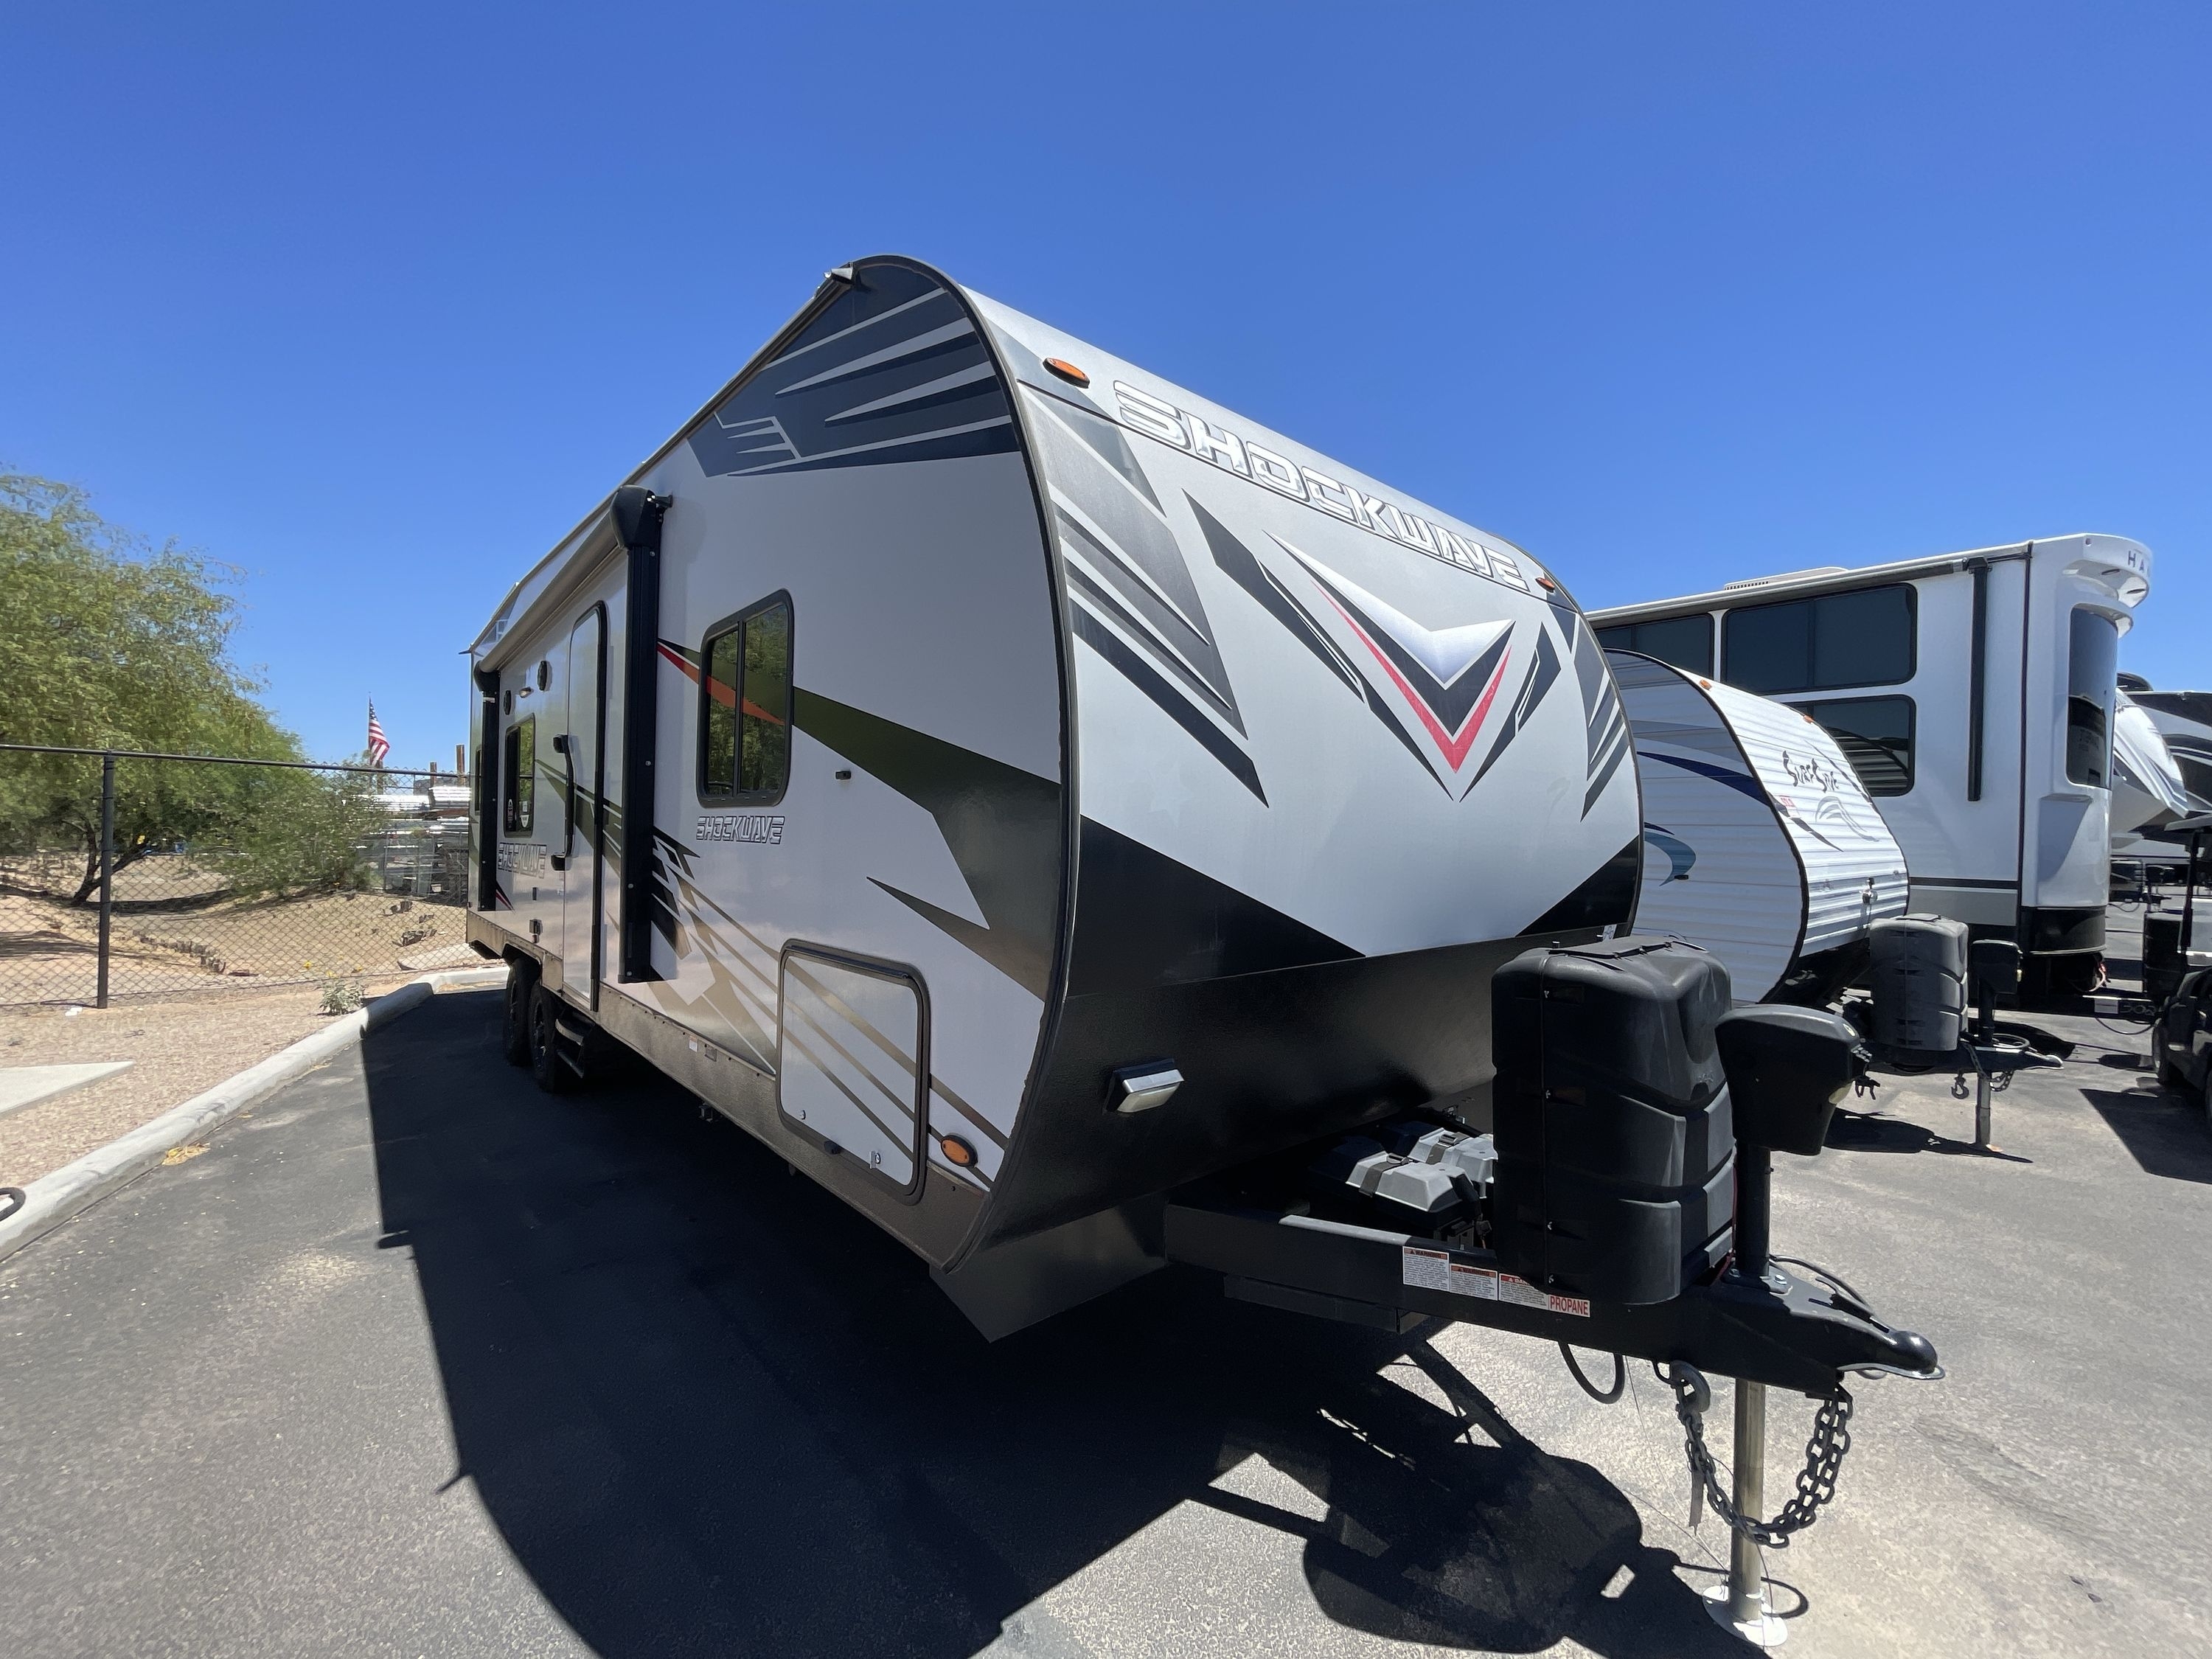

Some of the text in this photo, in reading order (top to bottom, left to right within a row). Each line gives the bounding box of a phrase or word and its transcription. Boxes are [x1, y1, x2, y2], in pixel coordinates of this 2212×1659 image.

[1113, 380, 1531, 591] SHOCKWAVE
[696, 815, 785, 844] SHOCKWAVE
[498, 842, 546, 879] SHOCKWAVE
[1550, 1295, 1588, 1316] PROPANE
